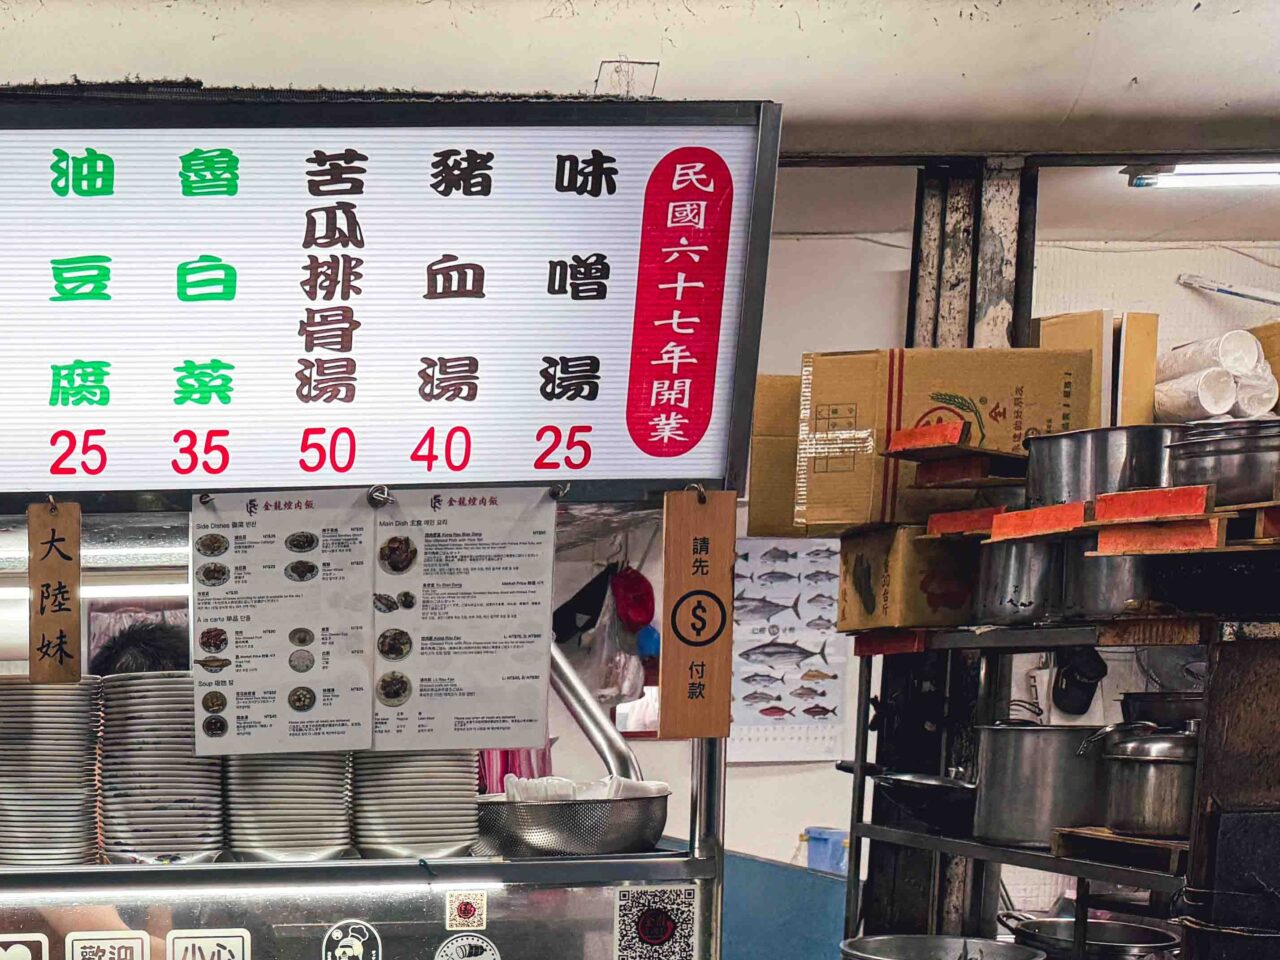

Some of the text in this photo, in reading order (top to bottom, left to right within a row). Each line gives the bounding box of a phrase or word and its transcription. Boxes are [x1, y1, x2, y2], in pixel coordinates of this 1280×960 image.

[50, 148, 114, 406] 油豆腐
[175, 149, 239, 405] 魯白菜
[296, 149, 368, 402] 苦瓜排骨湯
[419, 149, 494, 401] 豬血湯
[540, 150, 618, 401] 味噌湯
[650, 162, 715, 442] 民國六十七年開業
[50, 429, 106, 475] 25
[172, 430, 229, 474] 35
[299, 428, 355, 473] 50
[410, 426, 471, 471] 40
[534, 426, 592, 469] 25
[37, 528, 74, 668] 大陸妹
[692, 537, 710, 576] 請先
[688, 661, 706, 700] 付款
